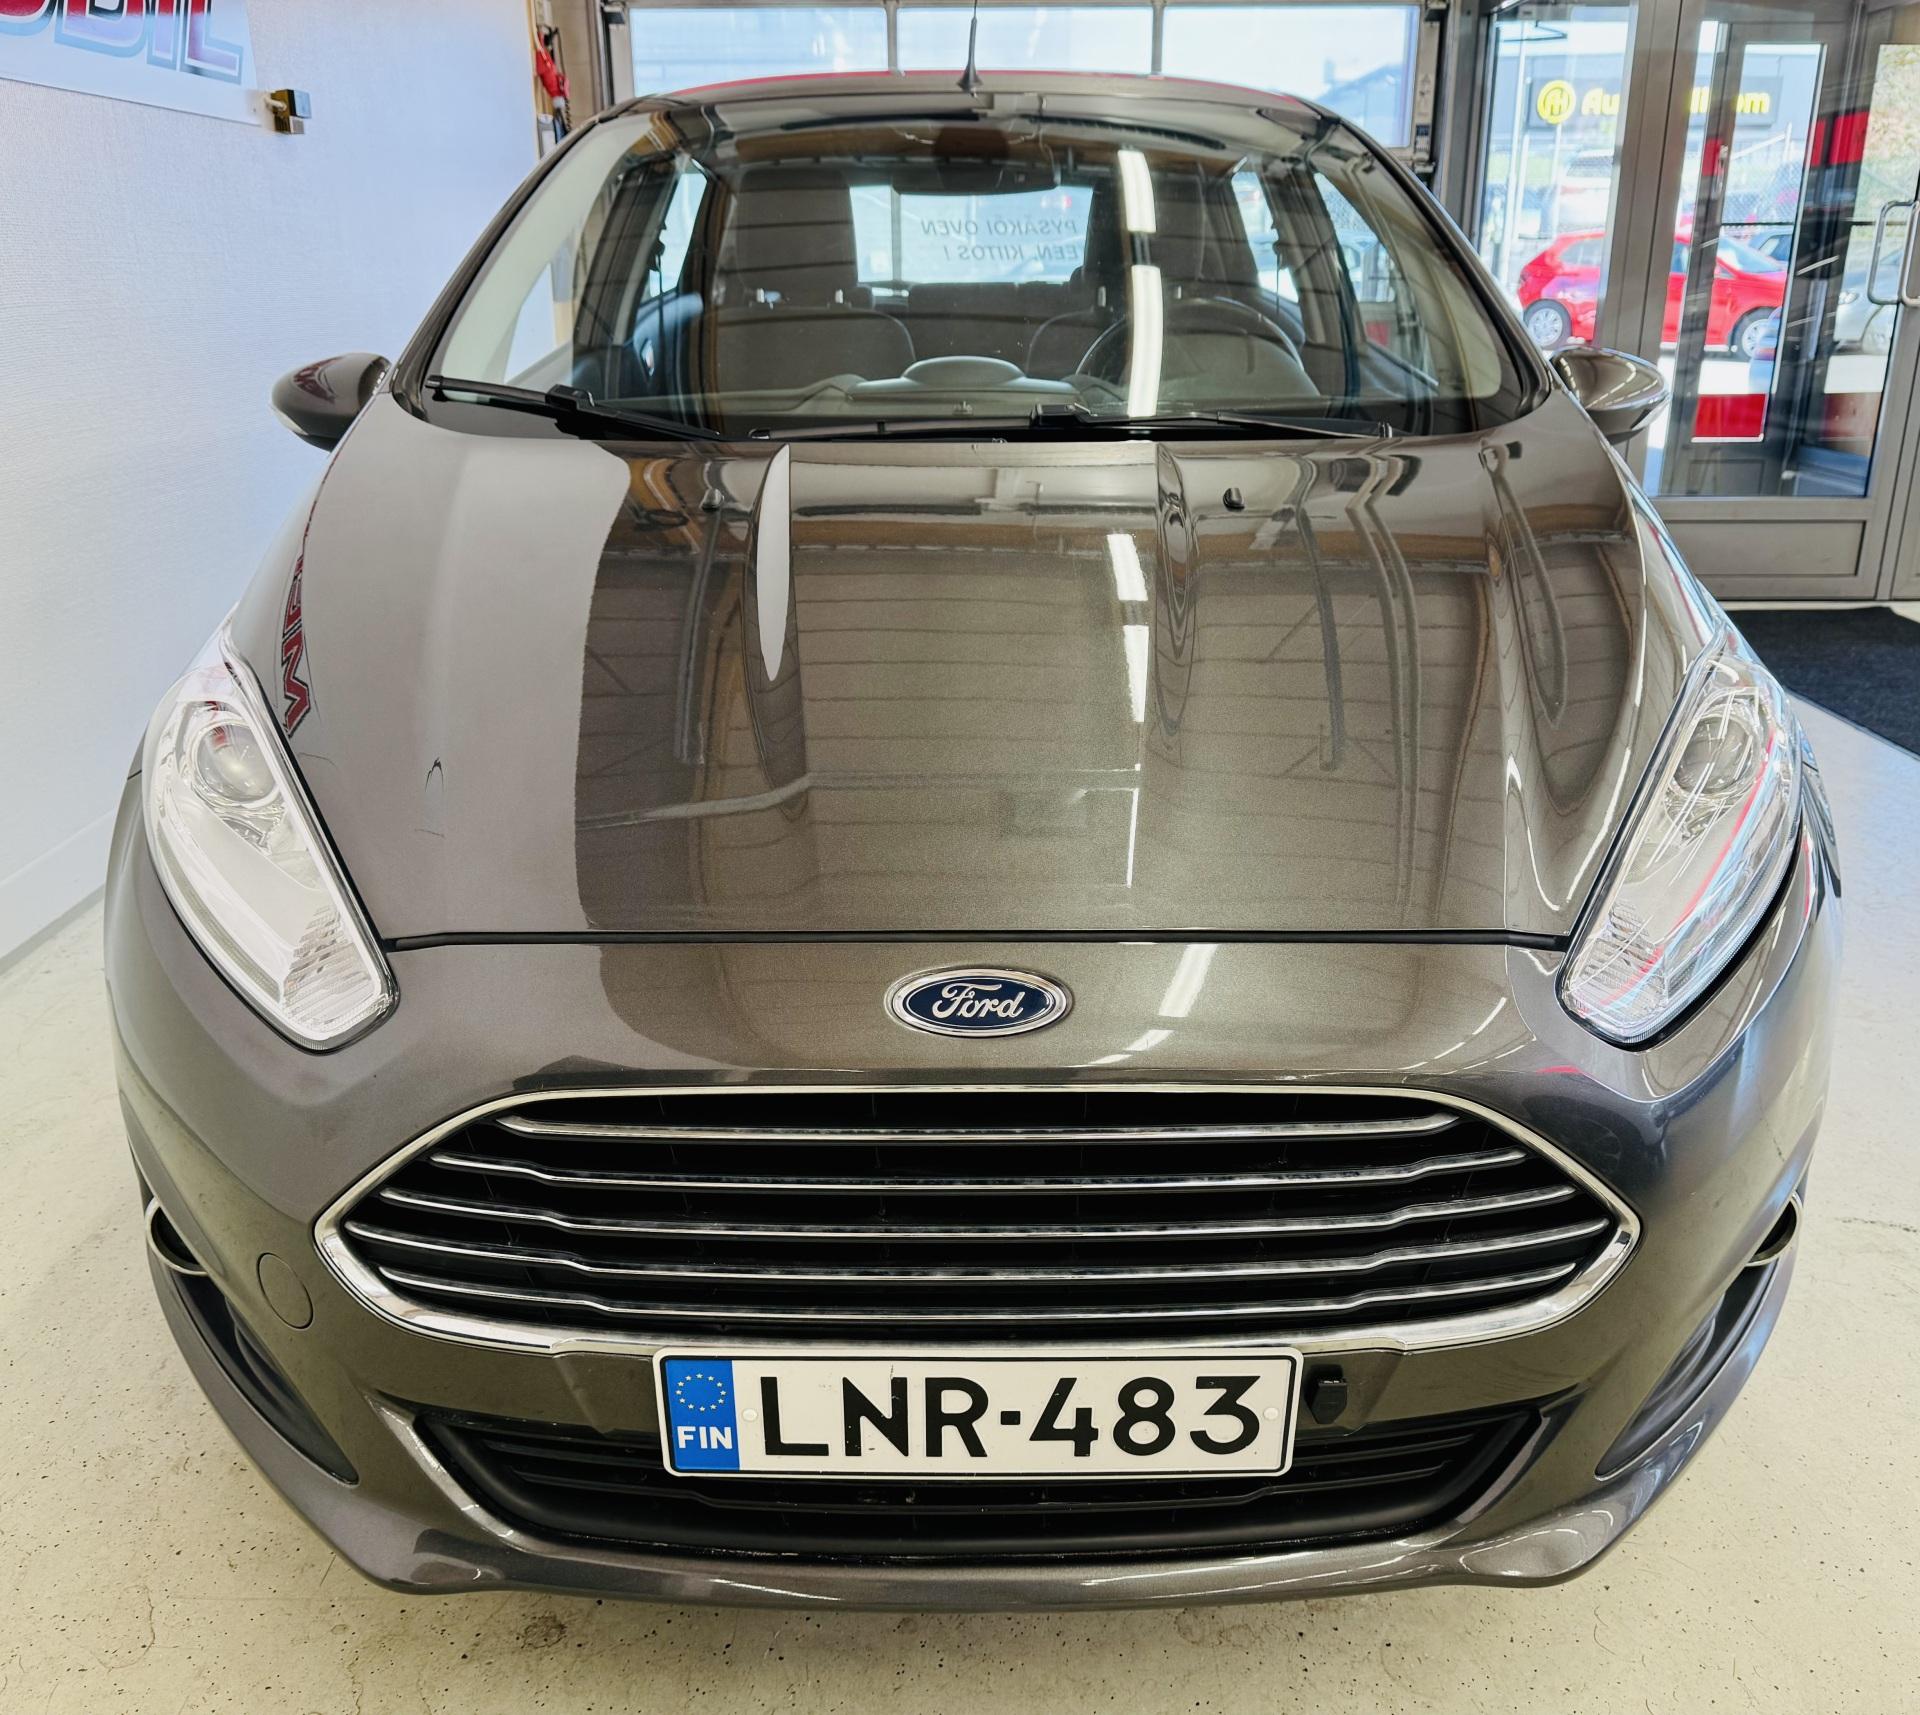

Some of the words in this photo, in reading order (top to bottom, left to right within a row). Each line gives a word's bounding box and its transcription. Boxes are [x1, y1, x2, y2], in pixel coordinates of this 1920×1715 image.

[0, 0, 243, 85] IL
[931, 983, 1025, 1018] Ford
[677, 1427, 734, 1449] FIN
[760, 1375, 1261, 1458] LNR-483
